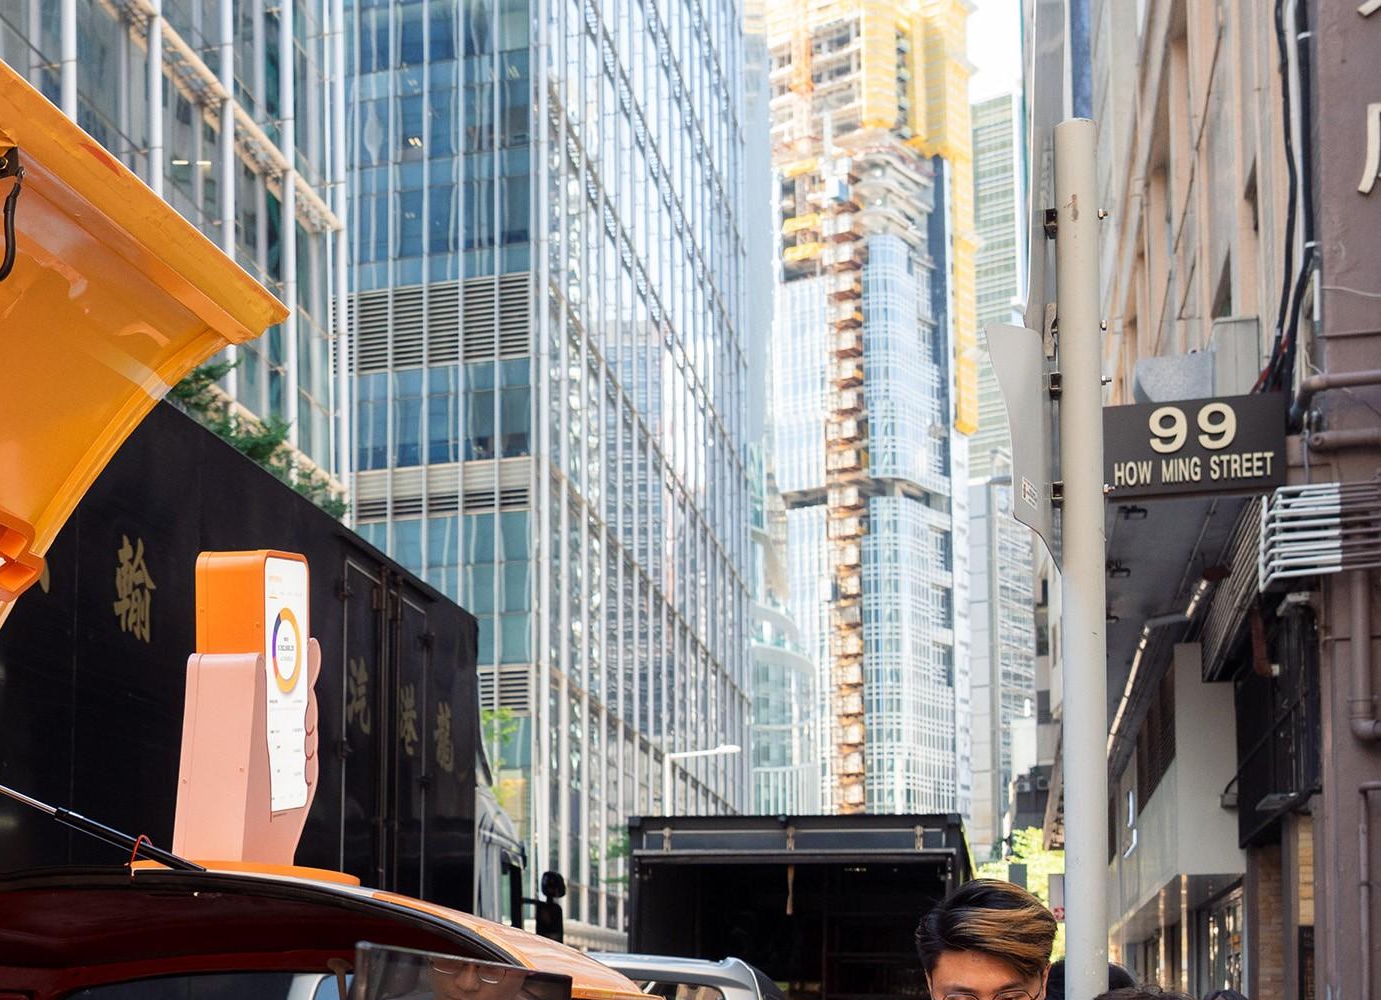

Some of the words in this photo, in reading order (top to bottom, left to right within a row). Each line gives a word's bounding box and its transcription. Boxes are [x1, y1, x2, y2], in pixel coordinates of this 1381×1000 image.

[1148, 402, 1237, 453] 99
[1113, 459, 1153, 487] HOW
[1161, 455, 1202, 483] MING
[1209, 451, 1275, 480] STREET
